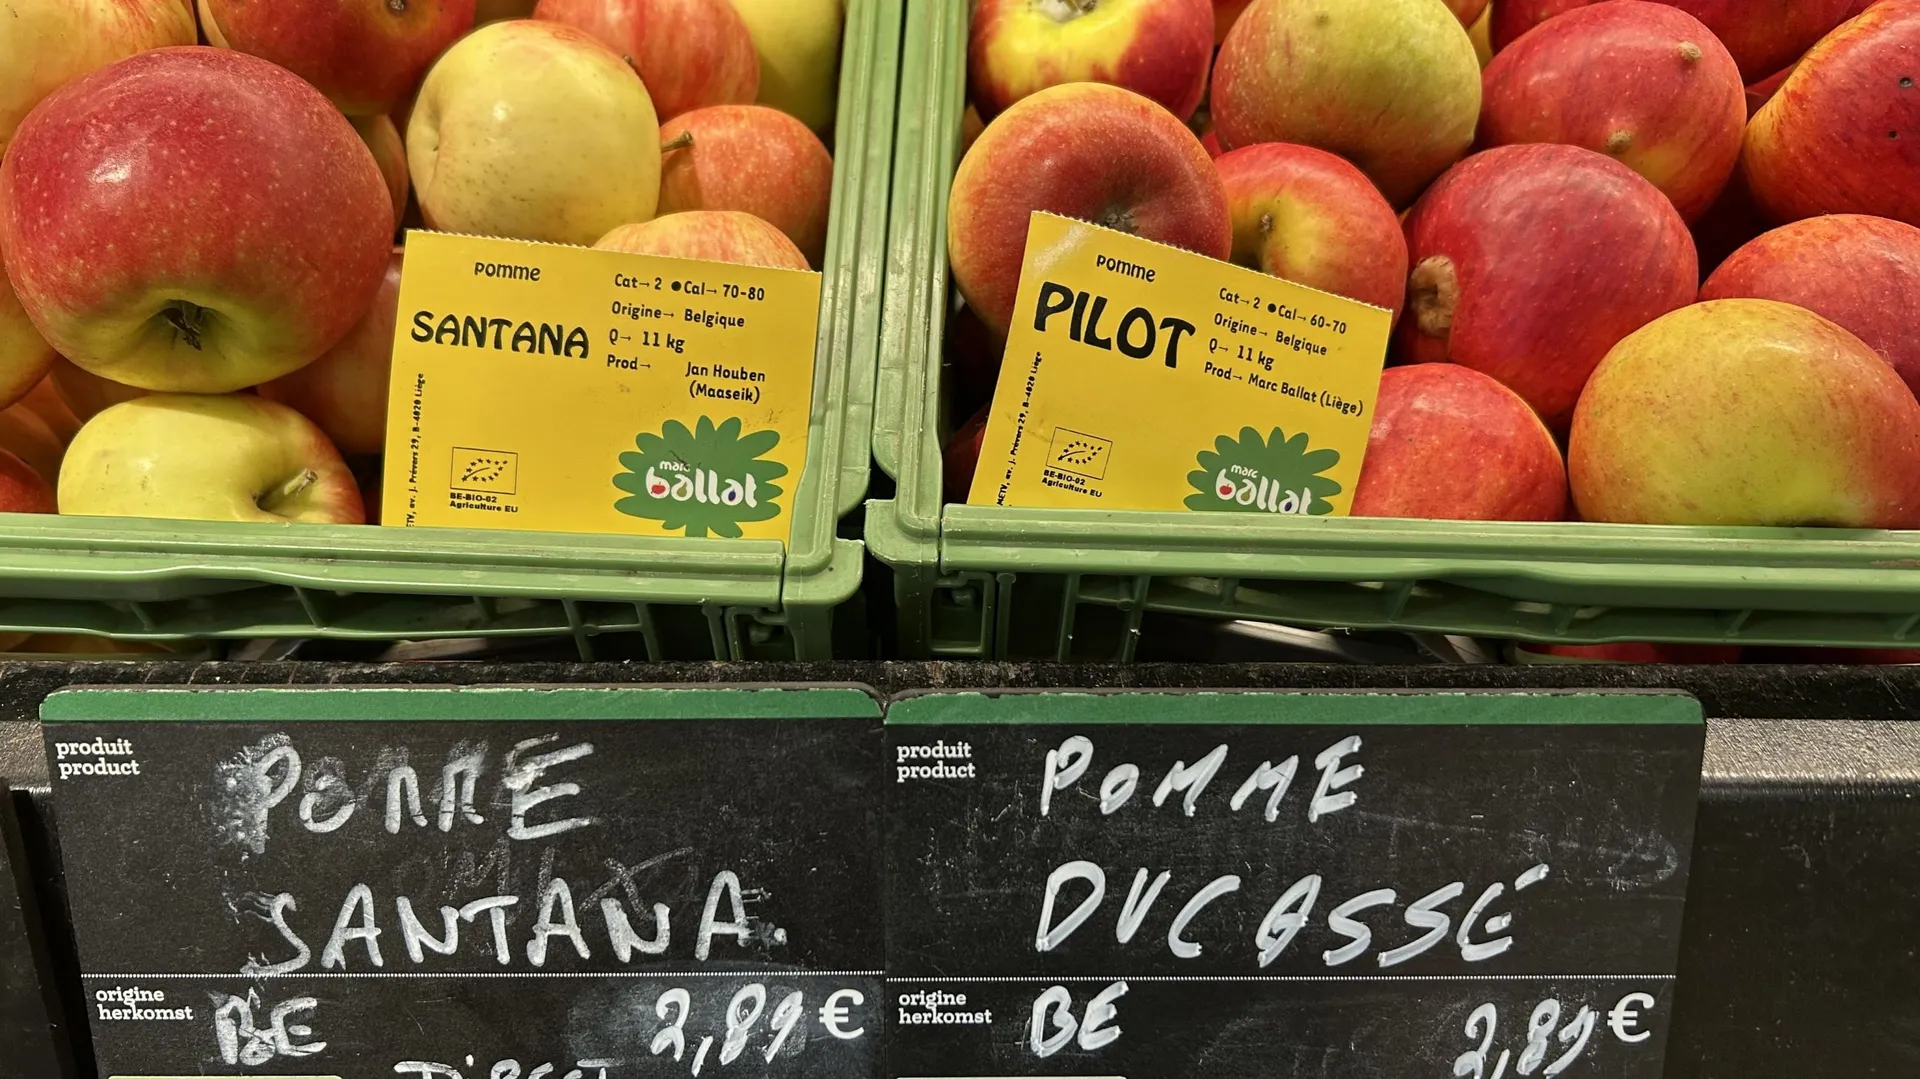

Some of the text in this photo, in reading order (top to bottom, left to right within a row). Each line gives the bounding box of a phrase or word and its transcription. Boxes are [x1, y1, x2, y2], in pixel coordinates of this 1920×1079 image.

[614, 273, 765, 301] Cat 2 Cal 70-80
[611, 301, 745, 329] Origine Belgique
[1219, 287, 1347, 335] Cat 2 Cal 60-70
[411, 310, 589, 359] SANTANA
[1034, 281, 1196, 368] PILOT
[1214, 313, 1327, 356] Origine Belgique
[609, 328, 685, 354] Q 11 kg
[1209, 338, 1274, 371] Q 11 kg
[607, 354, 766, 382] Prod Jan Houben
[689, 380, 761, 404] (Maaseik)
[1022, 375, 1035, 408] B-4020
[1204, 361, 1363, 417] Prod Marc Ballat (Liège)
[412, 399, 421, 432] B-4020
[659, 460, 691, 472] marc
[1043, 469, 1086, 486] BE-BIO-02
[1231, 464, 1258, 479] marc
[449, 492, 497, 503] BE-BIO-02
[645, 466, 758, 508] ballat
[1041, 477, 1103, 498] Agriculture EU
[449, 500, 518, 513] Agriculture EU
[55, 737, 133, 759] produit
[897, 740, 972, 763] produit
[58, 757, 140, 780] product
[897, 760, 976, 783] product
[1040, 735, 1365, 823] POMME
[95, 986, 164, 1006] origine
[899, 990, 966, 1010] origine
[98, 1002, 194, 1021] herkomst
[899, 1007, 992, 1025] herkomst
[1030, 980, 1129, 1058] BE
[1607, 992, 1654, 1043] €
[215, 993, 327, 1065] BE
[818, 987, 865, 1039] €
